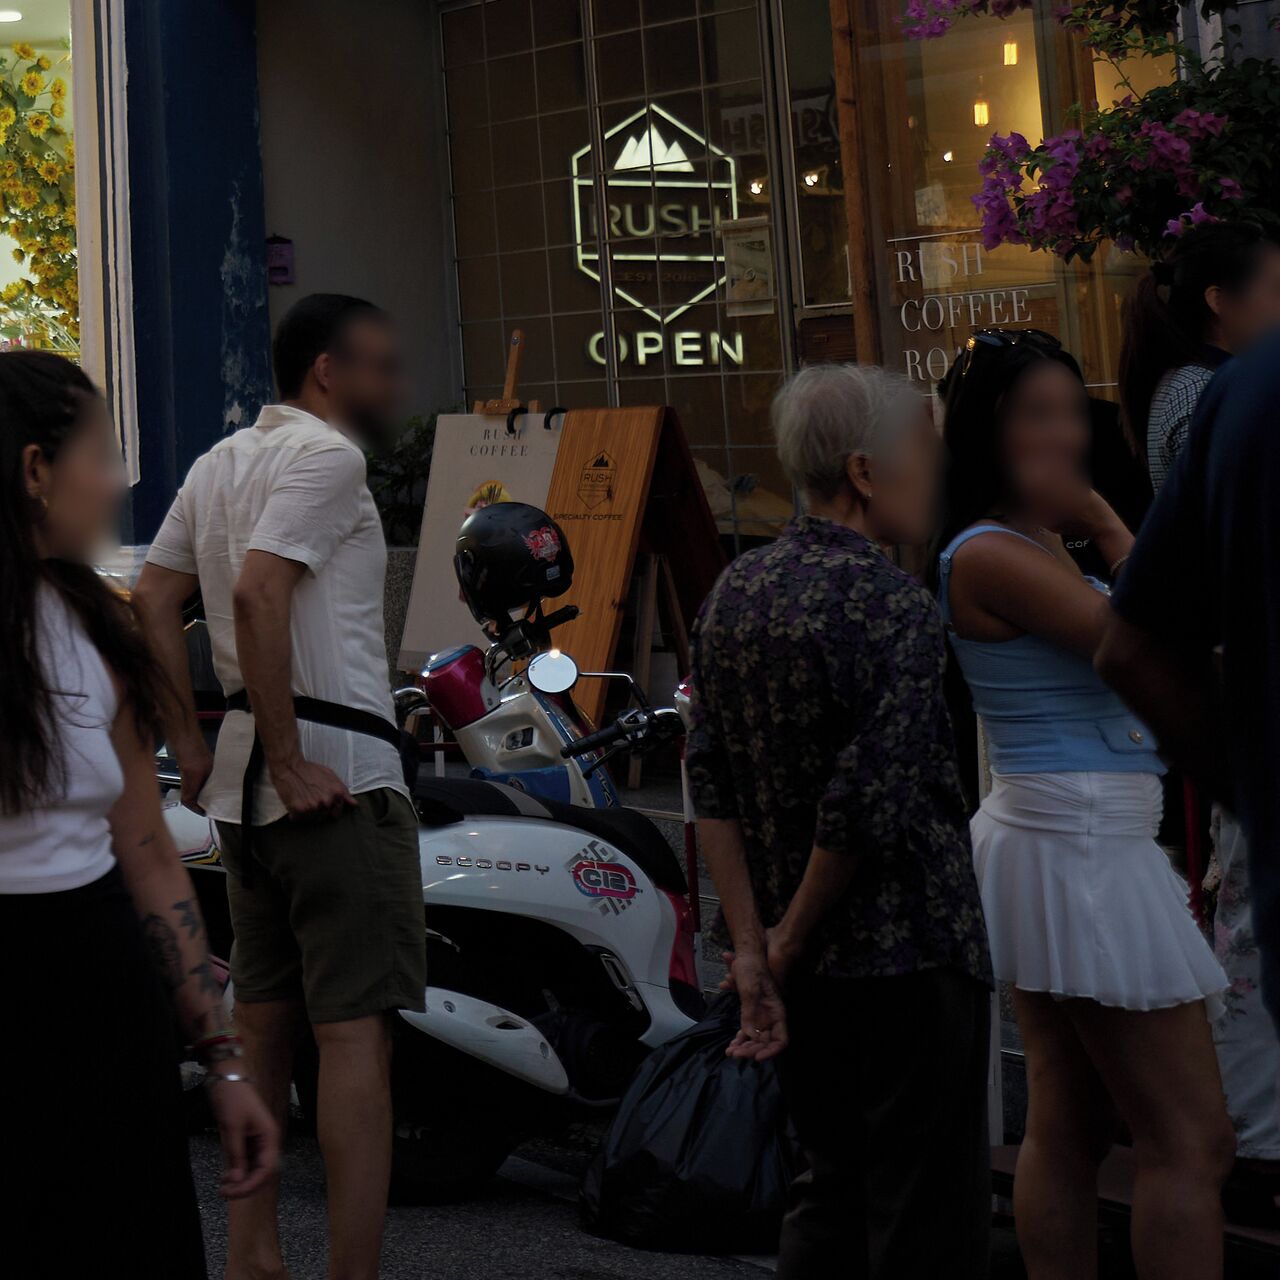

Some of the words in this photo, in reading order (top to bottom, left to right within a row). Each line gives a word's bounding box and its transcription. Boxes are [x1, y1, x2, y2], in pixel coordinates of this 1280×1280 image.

[590, 204, 722, 238] RUSH
[895, 243, 984, 283] RUSH
[900, 289, 1032, 332] COFFEE
[588, 331, 744, 366] OPEN
[903, 347, 959, 382] RO
[470, 445, 529, 457] COFFEE
[584, 473, 612, 483] RUSH
[435, 854, 550, 876] SCOOPY
